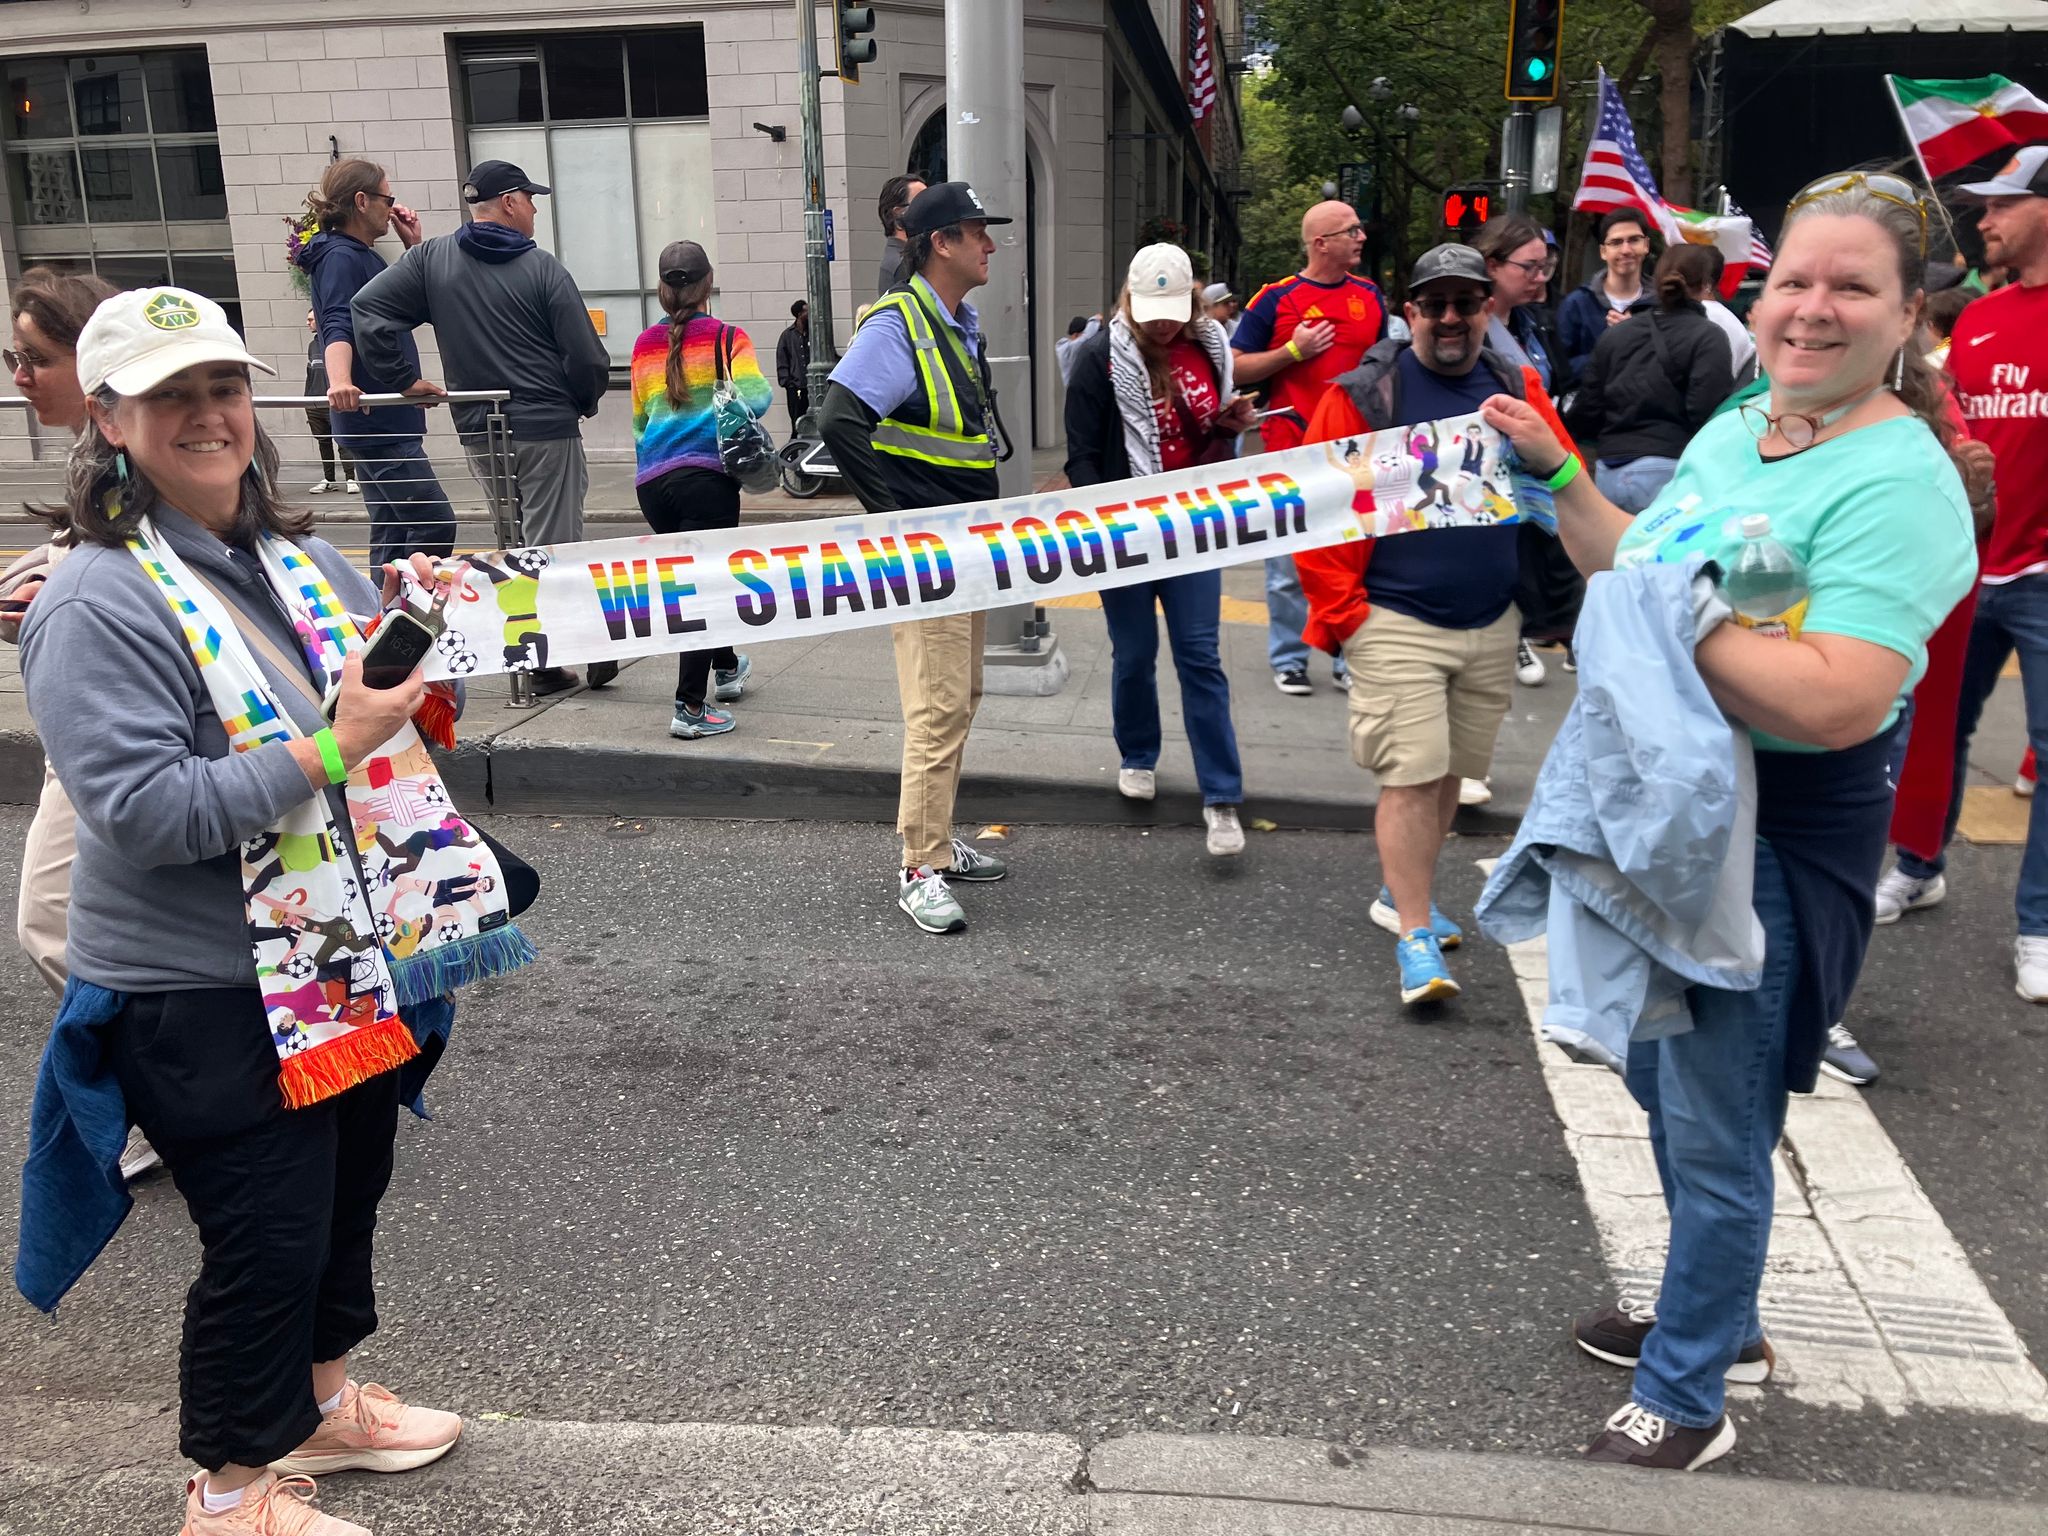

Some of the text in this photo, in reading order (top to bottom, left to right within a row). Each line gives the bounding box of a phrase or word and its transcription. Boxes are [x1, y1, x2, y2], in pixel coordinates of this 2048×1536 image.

[1474, 196, 1488, 223] 4
[1991, 363, 2030, 389] Fly
[588, 472, 1308, 641] WE STAND TOGETHER
[390, 634, 416, 657] 16:21
